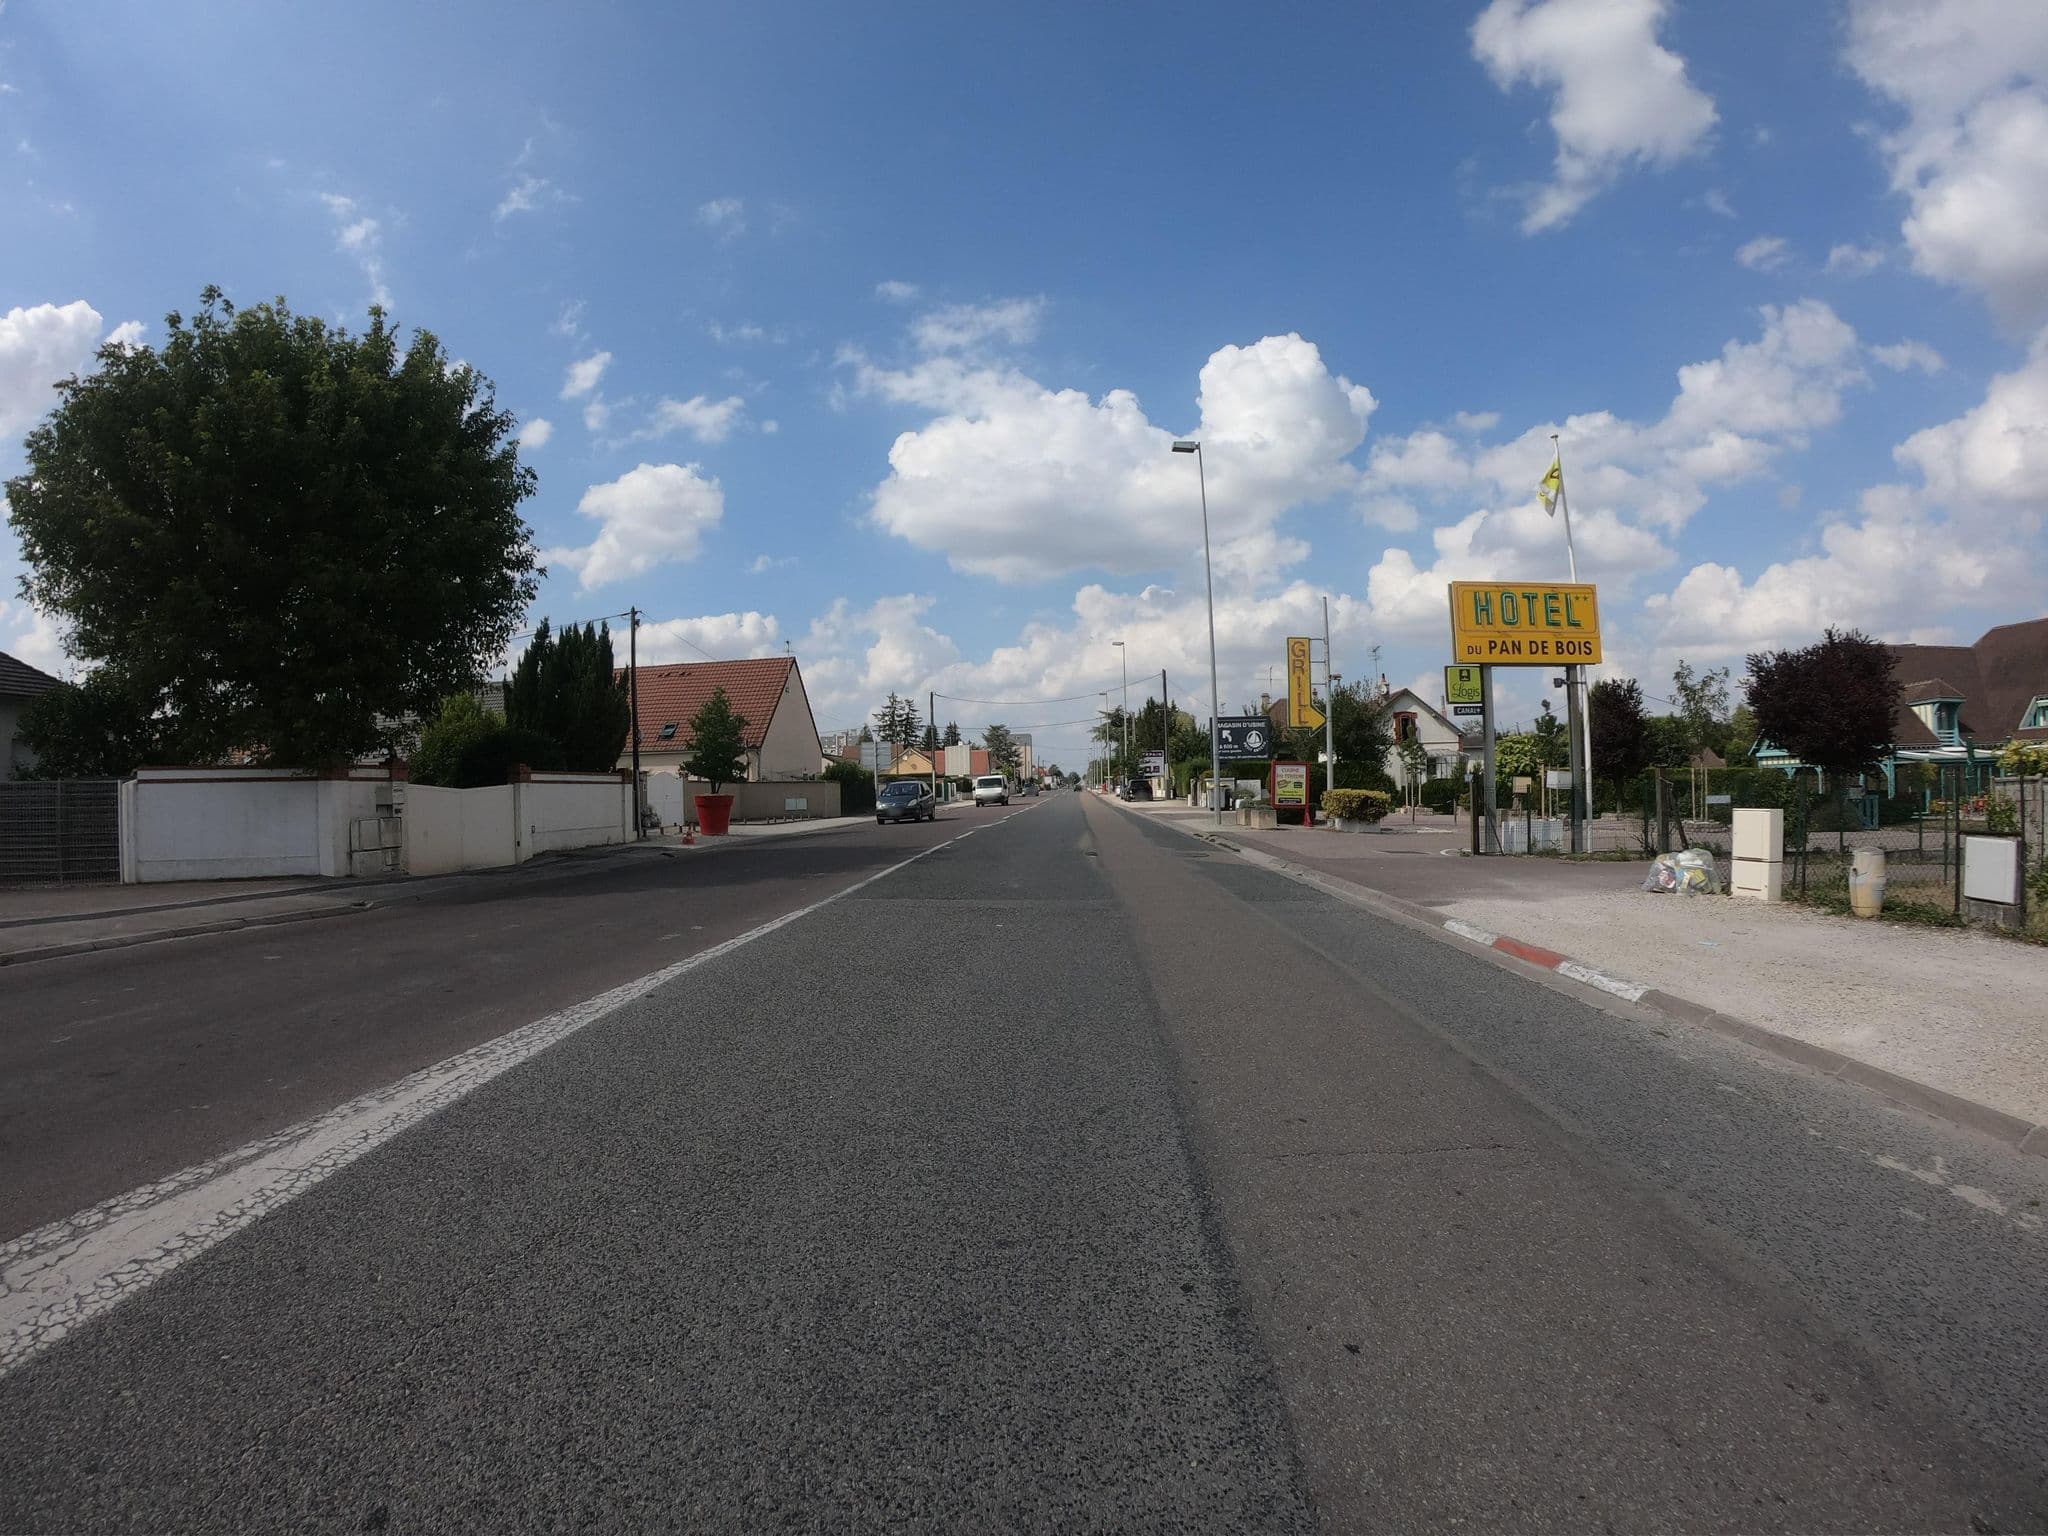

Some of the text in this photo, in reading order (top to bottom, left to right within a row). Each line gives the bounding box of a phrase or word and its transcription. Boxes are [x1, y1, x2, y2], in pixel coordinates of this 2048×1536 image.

[1473, 591, 1582, 627] HOTEL
[1467, 640, 1593, 656] DU PAN DE BOIS
[1291, 640, 1309, 725] GRILL
[1451, 683, 1480, 700] Logis
